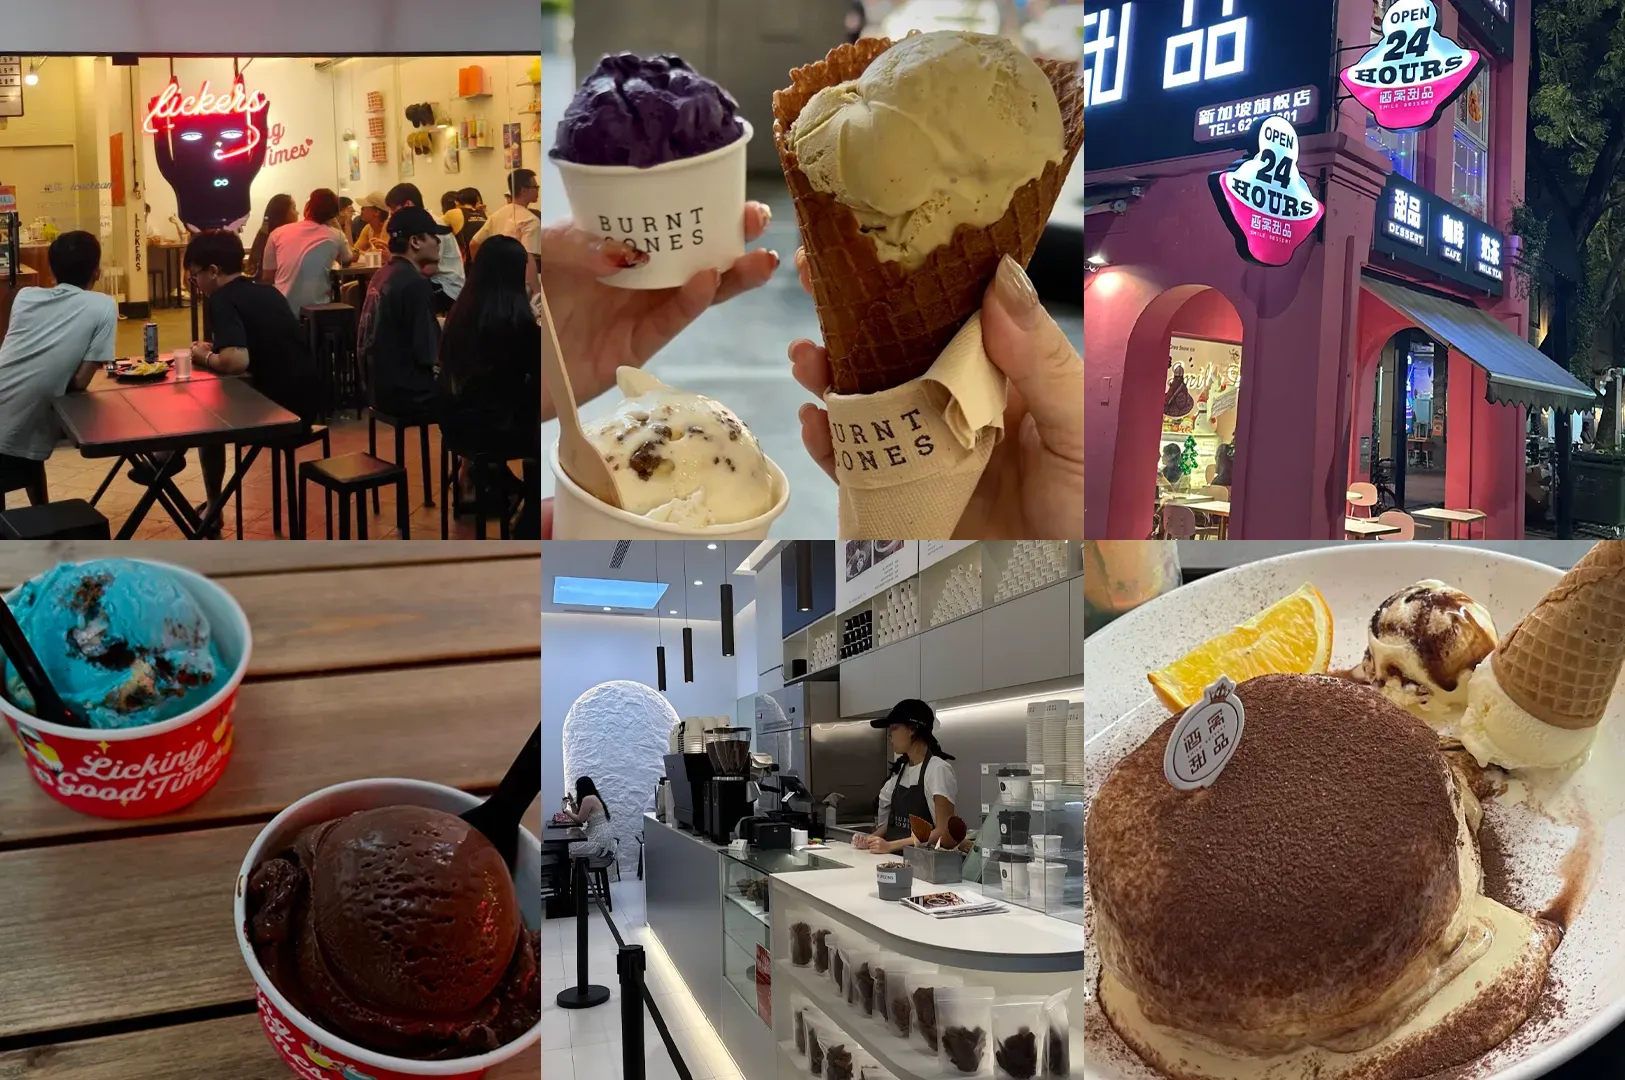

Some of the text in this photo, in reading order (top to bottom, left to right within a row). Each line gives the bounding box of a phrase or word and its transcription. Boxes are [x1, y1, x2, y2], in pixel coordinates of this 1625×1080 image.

[1390, 6, 1430, 24] OPEN
[1382, 26, 1432, 62] 24
[1354, 55, 1463, 85] HOURS
[1198, 89, 1311, 125] 新加坡旗舰店
[1208, 122, 1236, 137] TEL:
[1264, 126, 1294, 149] OPEN
[1256, 149, 1293, 189] 24
[1232, 177, 1313, 217] HOURS
[1394, 188, 1420, 230] 甜品
[598, 207, 703, 233] BURNT
[1388, 222, 1424, 245] DESSERT
[604, 229, 704, 253] ONES
[1444, 247, 1461, 262] CAFE
[832, 408, 922, 444] URNT
[834, 434, 934, 471] ONES
[56, 772, 147, 801] Good
[147, 747, 223, 799] Times
[76, 739, 208, 781] Licking
